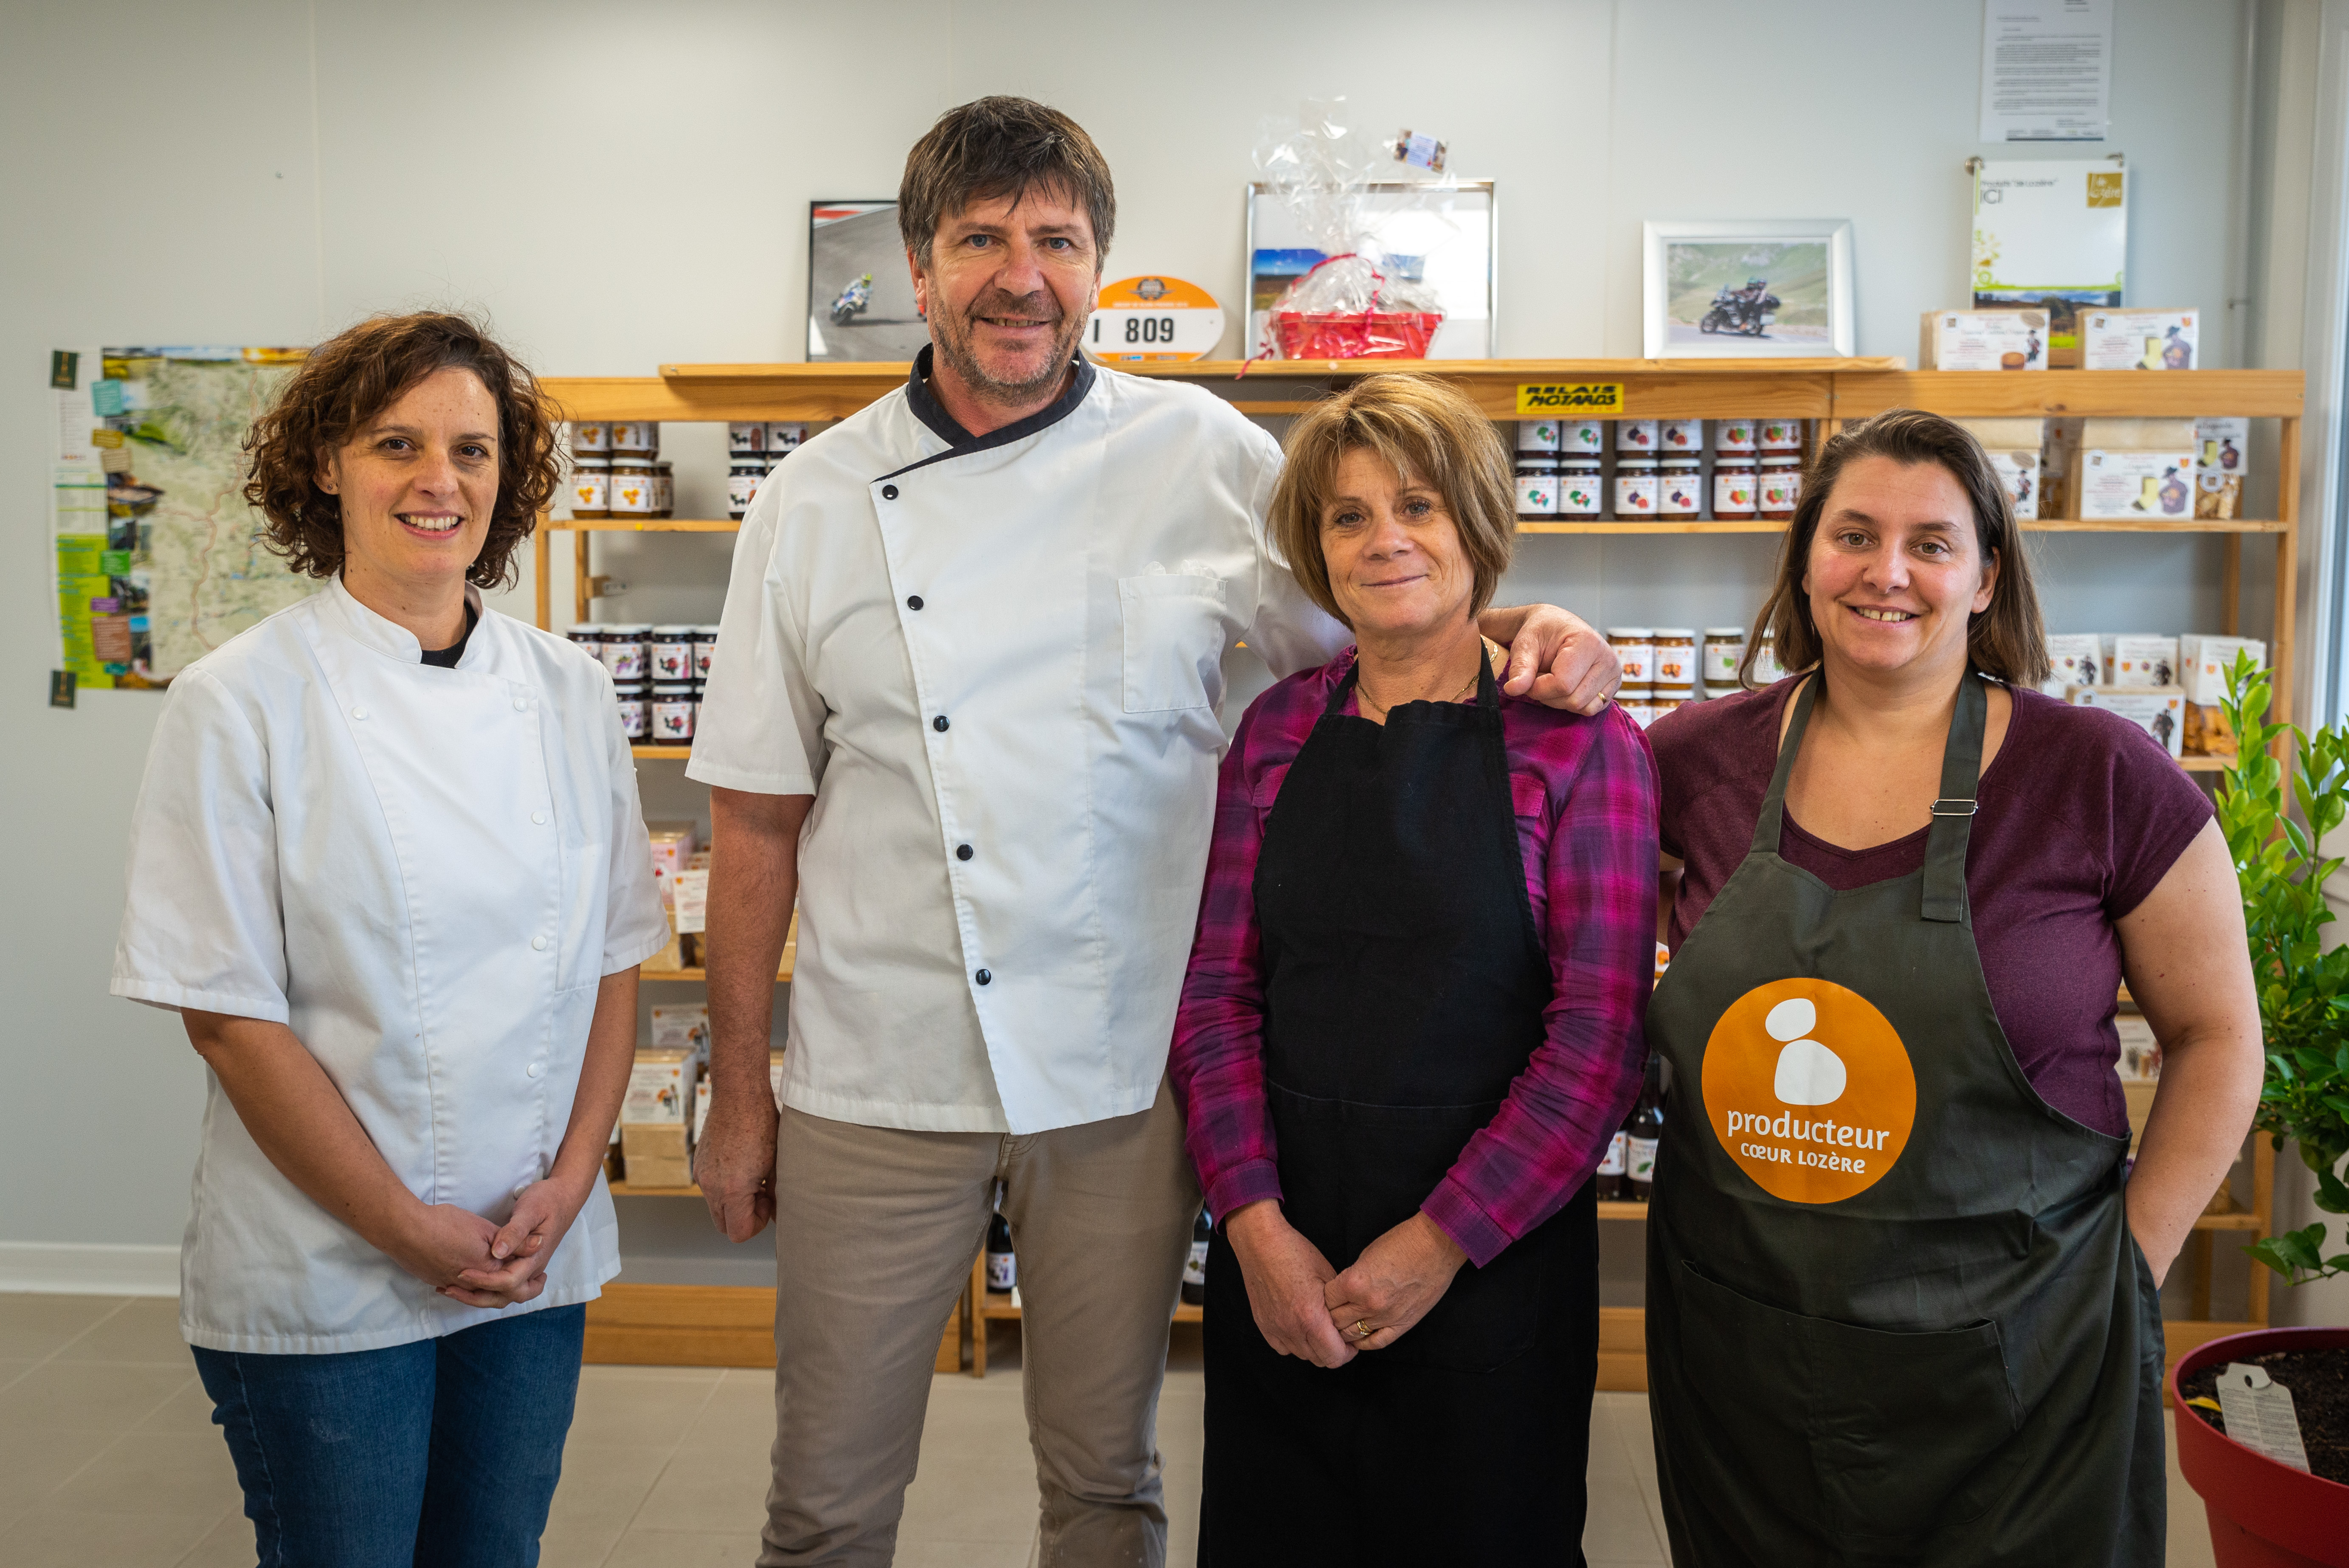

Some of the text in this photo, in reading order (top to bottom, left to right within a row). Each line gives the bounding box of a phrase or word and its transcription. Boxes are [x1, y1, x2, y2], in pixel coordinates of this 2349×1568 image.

[1125, 318, 1174, 343] 809
[1526, 386, 1616, 394] RELAIS
[1527, 394, 1616, 406] MOTARDS
[1727, 1110, 1890, 1151] producteur
